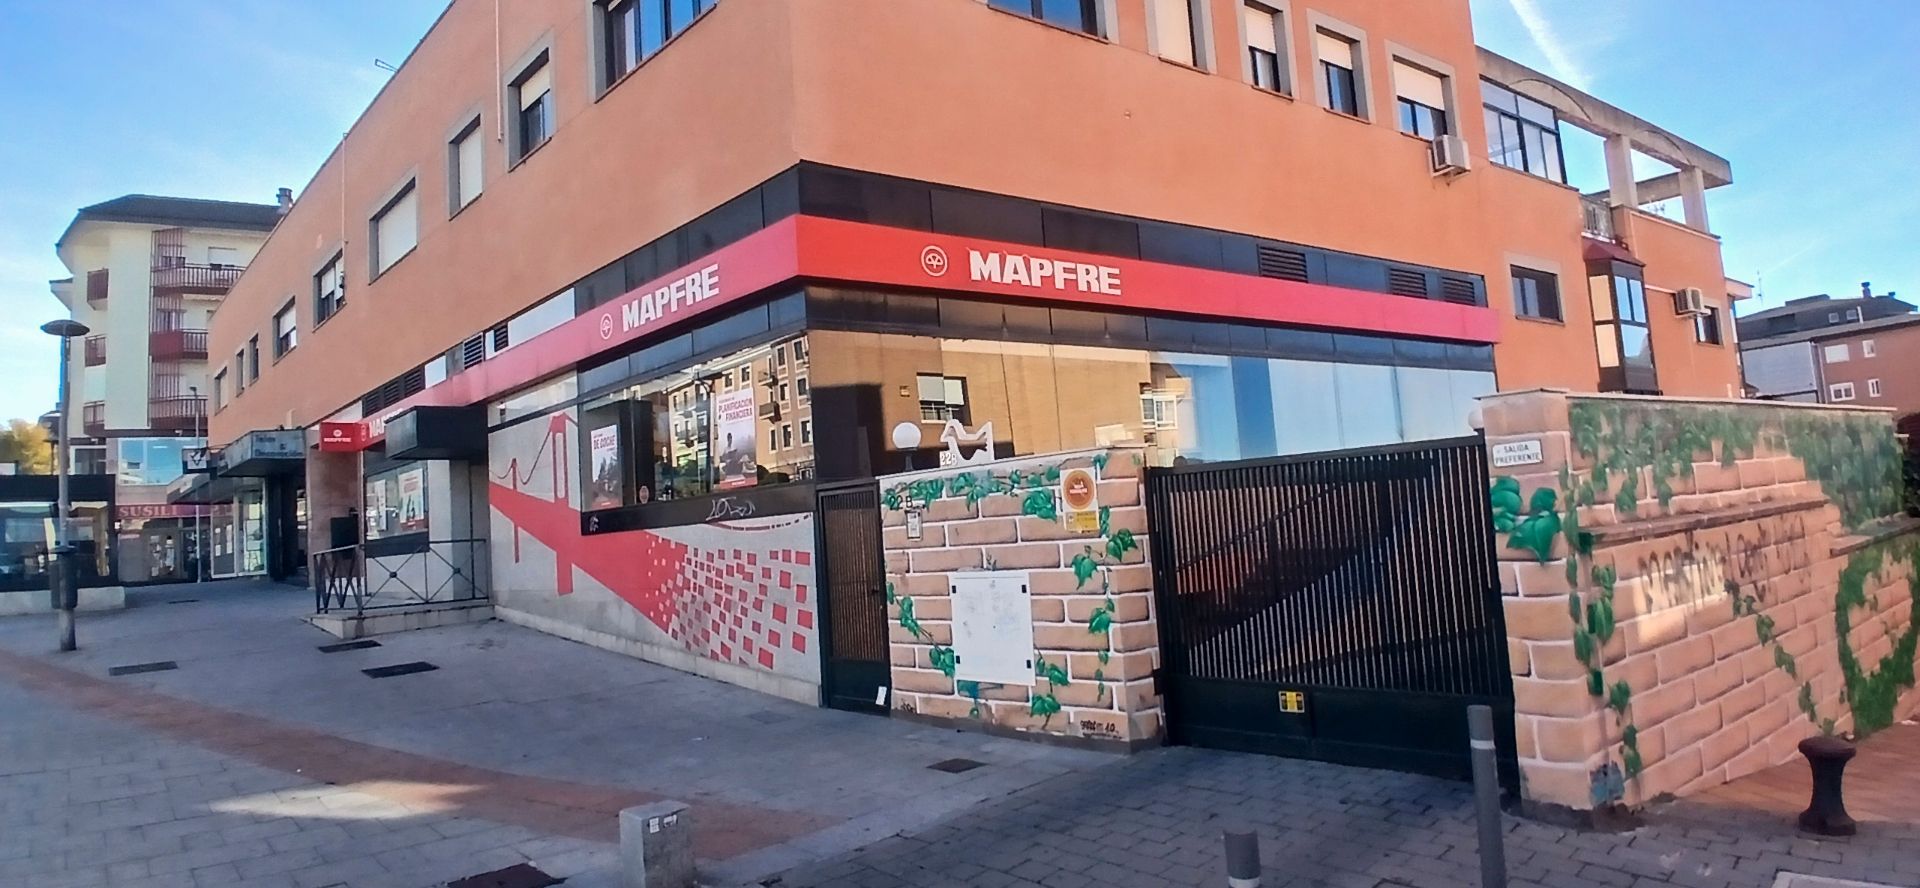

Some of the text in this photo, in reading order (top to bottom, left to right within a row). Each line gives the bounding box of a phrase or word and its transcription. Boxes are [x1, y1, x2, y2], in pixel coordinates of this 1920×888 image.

[968, 249, 1121, 295] MAPFRE
[621, 263, 720, 332] MAPFRE
[1495, 451, 1540, 465] PREFERENTE
[1503, 444, 1529, 453] SALIDA
